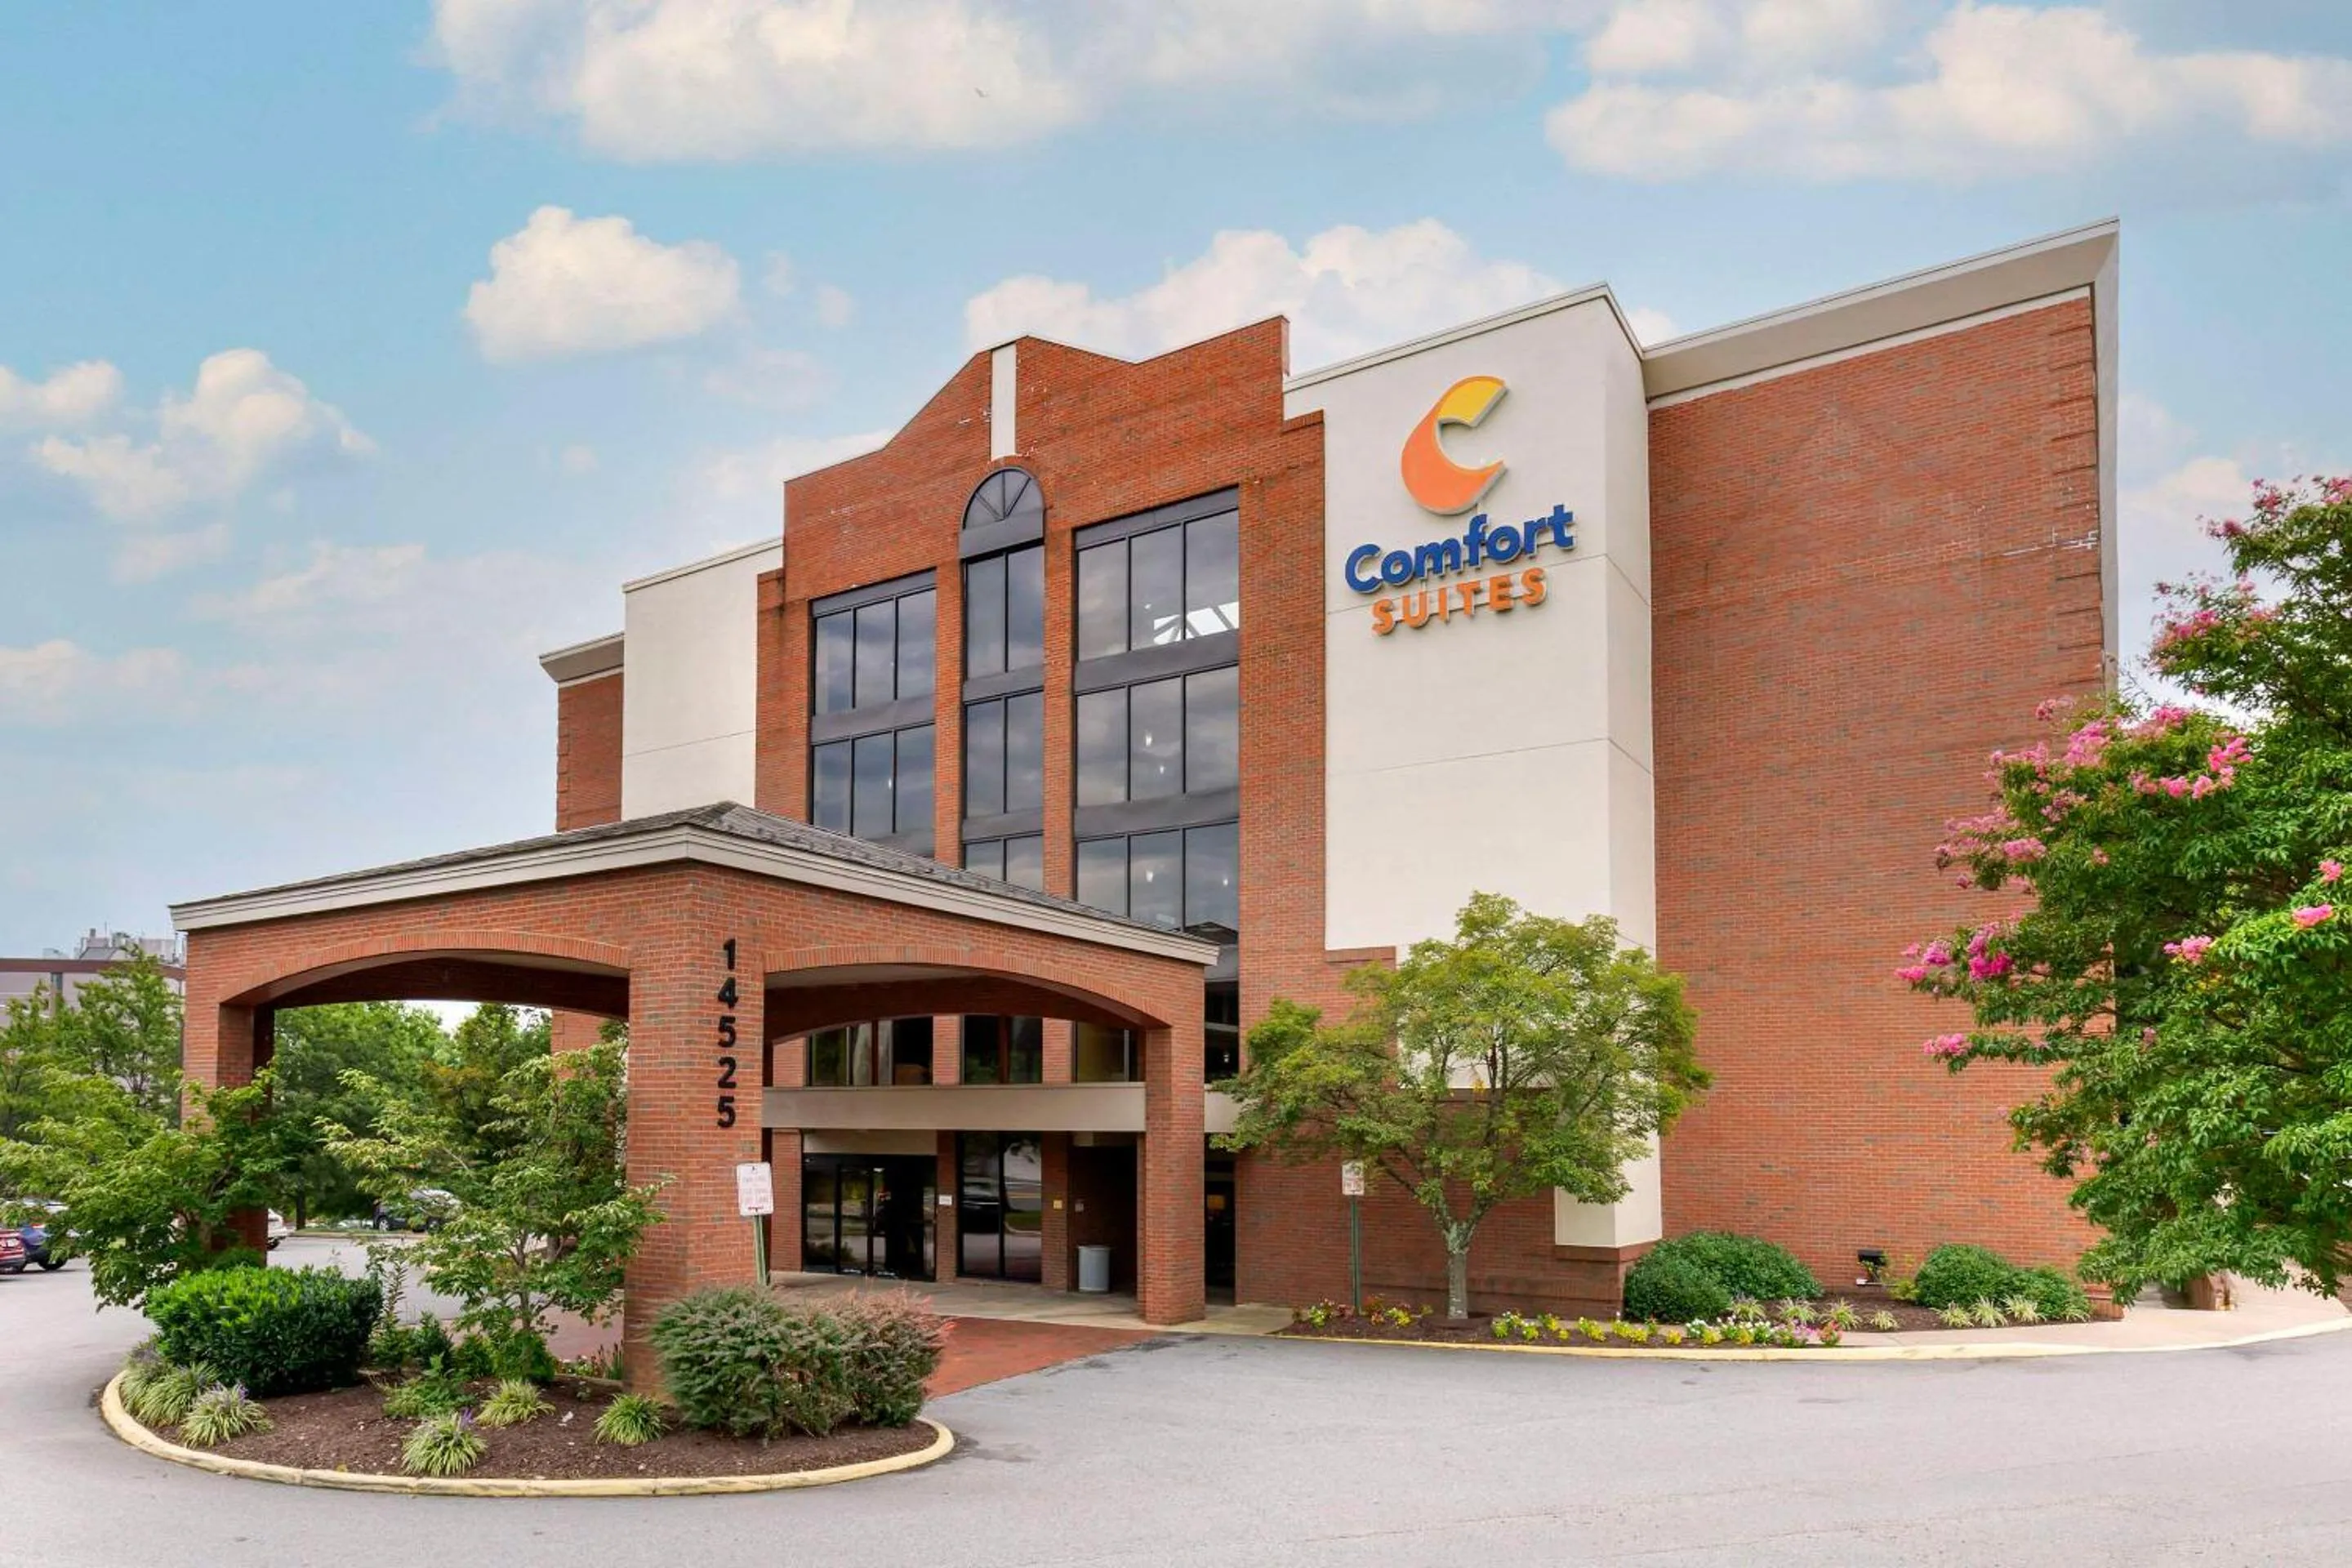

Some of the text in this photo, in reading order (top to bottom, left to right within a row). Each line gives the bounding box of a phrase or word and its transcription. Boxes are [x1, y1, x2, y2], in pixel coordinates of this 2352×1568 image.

[1345, 504, 1576, 594] Comfort
[1371, 567, 1548, 635] SUITES
[717, 938, 738, 1128] 14525
